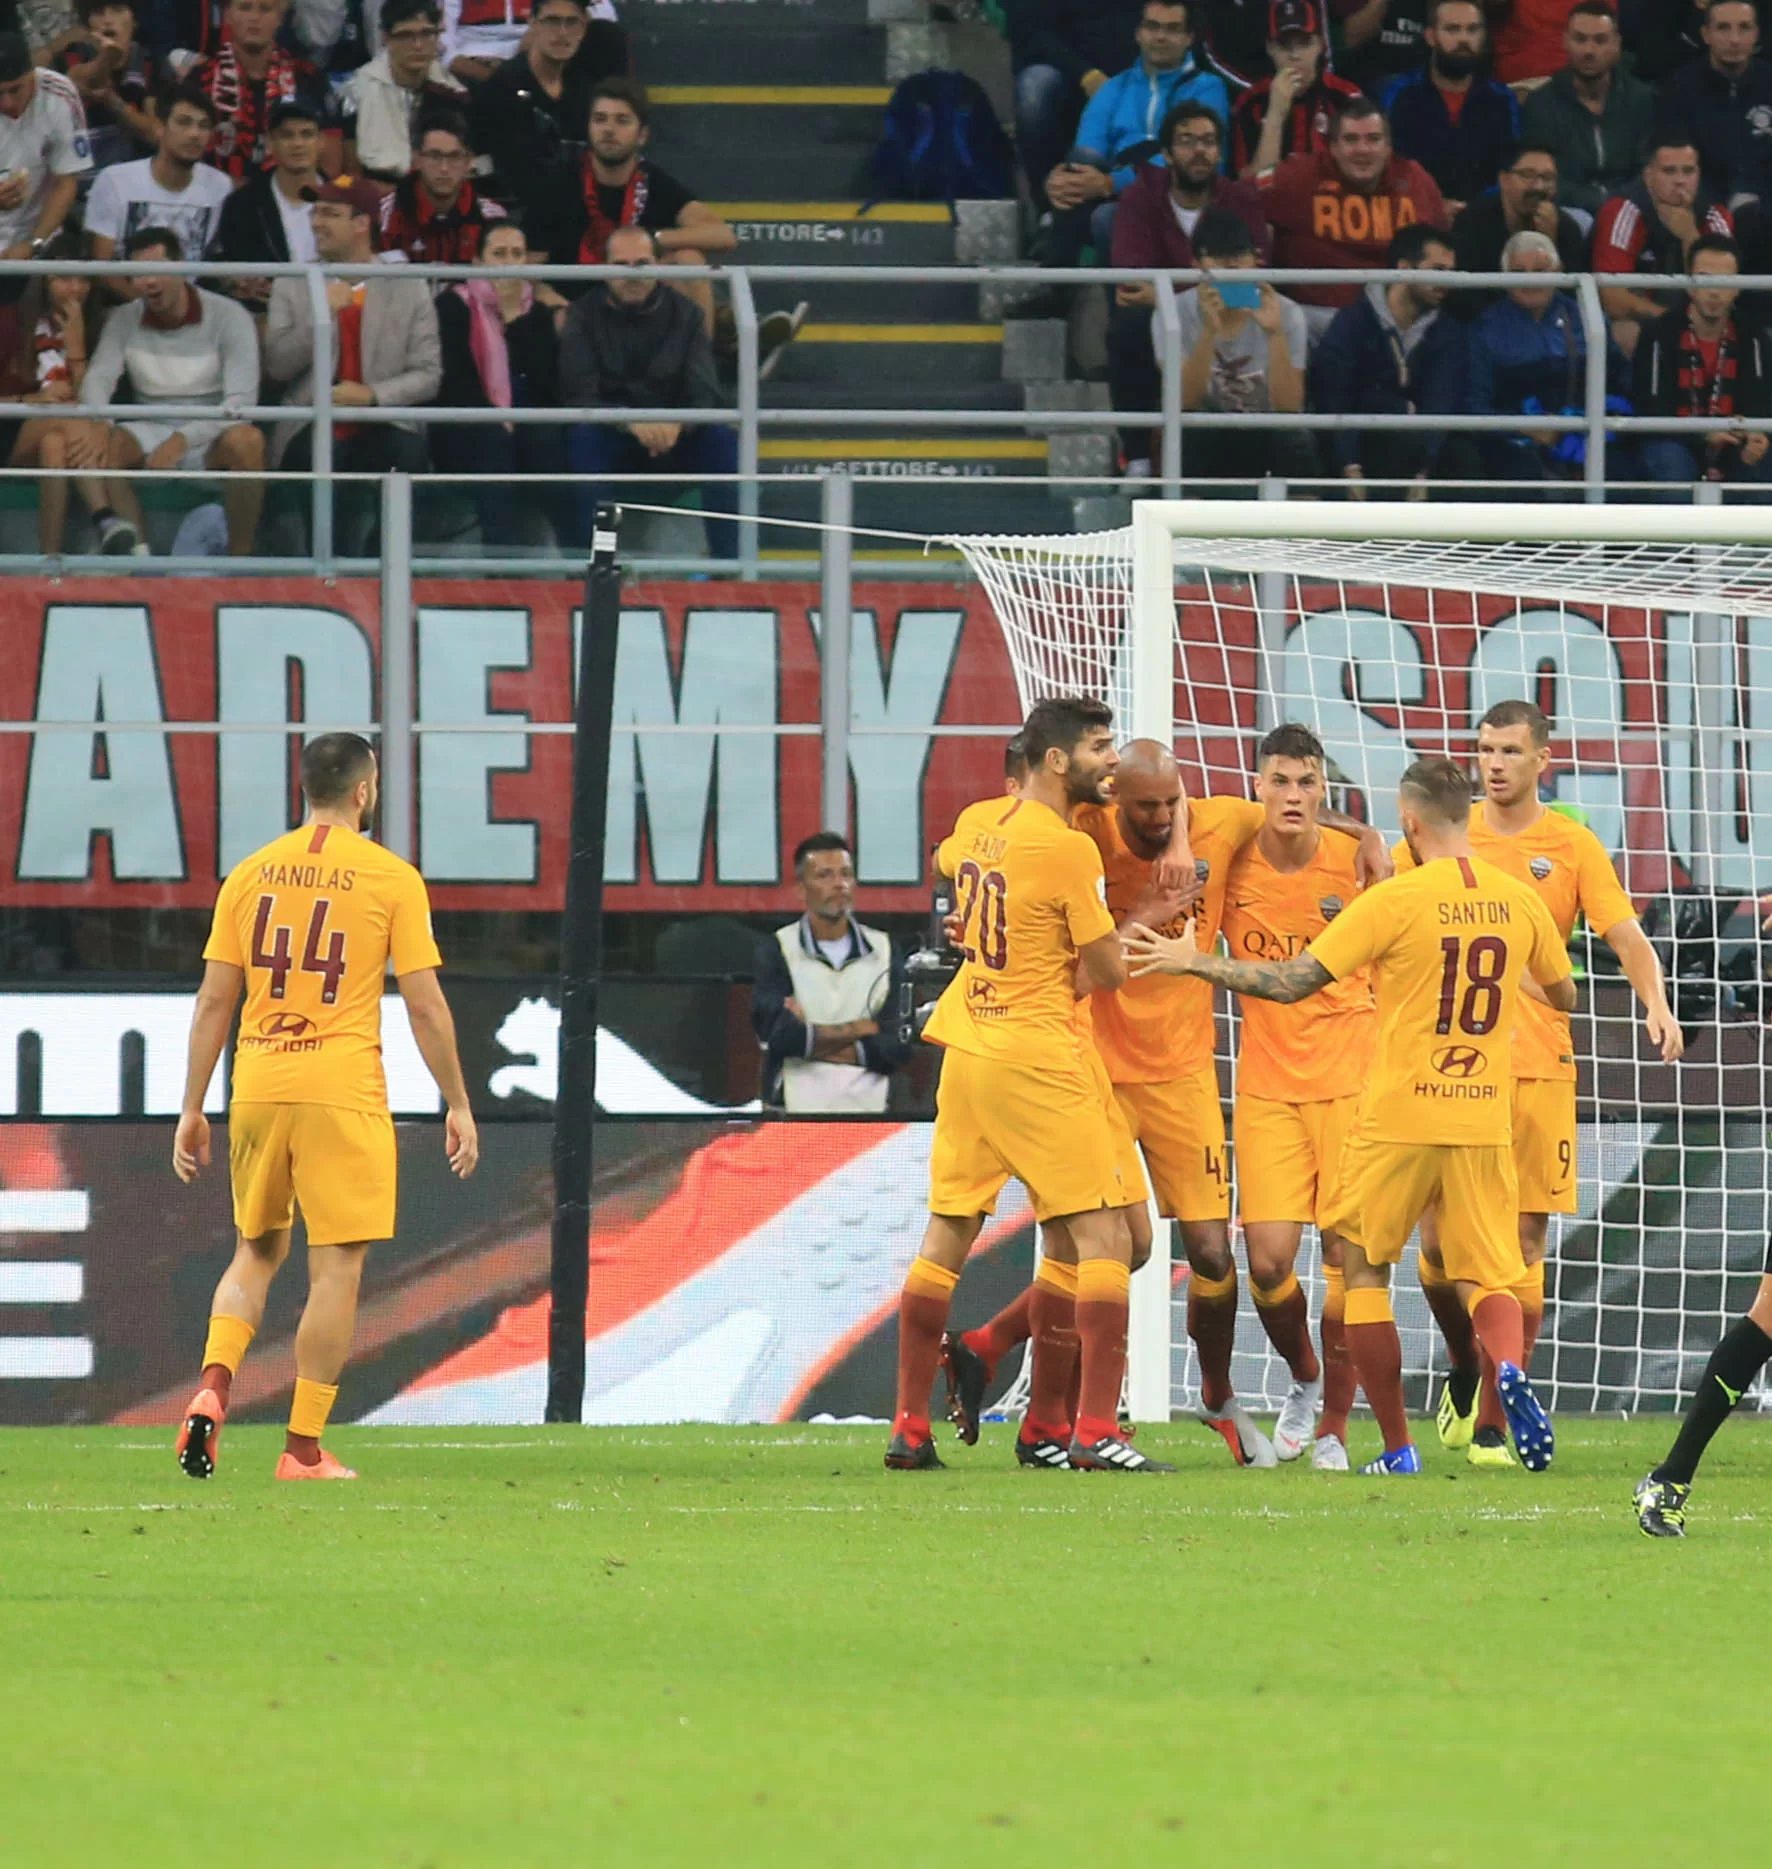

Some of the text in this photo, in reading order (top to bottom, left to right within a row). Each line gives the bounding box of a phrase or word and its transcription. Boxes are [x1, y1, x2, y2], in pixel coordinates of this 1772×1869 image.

[729, 213, 827, 243] ETTORE
[1313, 194, 1417, 241] ROMA
[258, 862, 357, 892] MANOLAS
[958, 860, 1008, 970] 20
[1437, 900, 1512, 926] SANTON
[250, 893, 347, 1006] 44
[1243, 929, 1313, 958] QATA
[1434, 935, 1508, 1036] 18
[1414, 1081, 1498, 1100] HYUNDAI
[1558, 1139, 1570, 1179] 9
